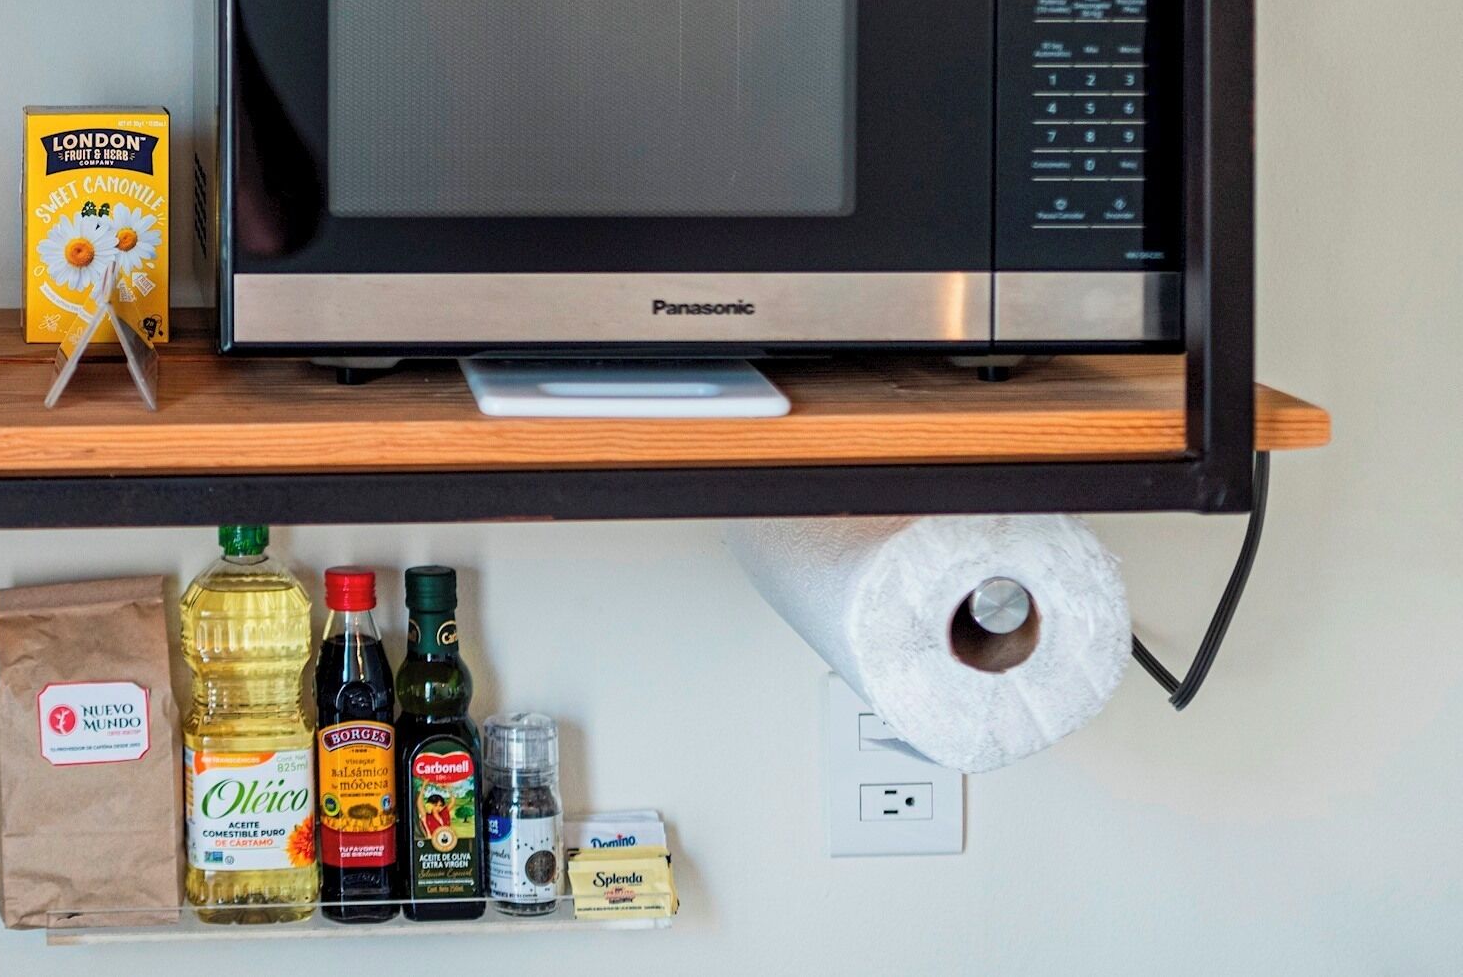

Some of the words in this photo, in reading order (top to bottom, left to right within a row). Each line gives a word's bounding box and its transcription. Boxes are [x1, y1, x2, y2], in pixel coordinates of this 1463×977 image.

[1048, 74, 1057, 86] 1
[1085, 74, 1096, 86] 2
[1124, 74, 1134, 86] 3
[1046, 103, 1056, 114] 4
[1085, 103, 1095, 114] 5
[1124, 102, 1134, 114] 6
[52, 133, 140, 151] LONDON
[1047, 131, 1056, 142] 7
[1085, 130, 1095, 142] 8
[1123, 130, 1134, 142] 9
[64, 149, 92, 161] FRUIT
[94, 149, 101, 160] &
[104, 149, 129, 161] HERB
[1085, 159, 1095, 171] 0
[35, 180, 79, 223] SWEET
[83, 176, 165, 211] CAMOMILE
[652, 299, 755, 315] Panasonic
[81, 704, 134, 718] NUEVO
[83, 717, 141, 732] MUNDO
[331, 729, 387, 744] BORGES
[277, 762, 308, 773] 825ml
[416, 760, 469, 774] Carbonell
[201, 778, 309, 819] Oléico
[228, 821, 260, 829] ACEITE
[202, 829, 258, 838] COMESTIBLE
[261, 828, 286, 837] PURO
[215, 839, 226, 847] DE
[590, 834, 636, 848] Domino
[419, 853, 441, 862] ACEITE
[441, 853, 451, 861] DE
[451, 852, 471, 861] OLIVA
[422, 861, 443, 869] EXTRA
[444, 860, 468, 869] VIRGEN
[593, 872, 643, 887] Splenda
